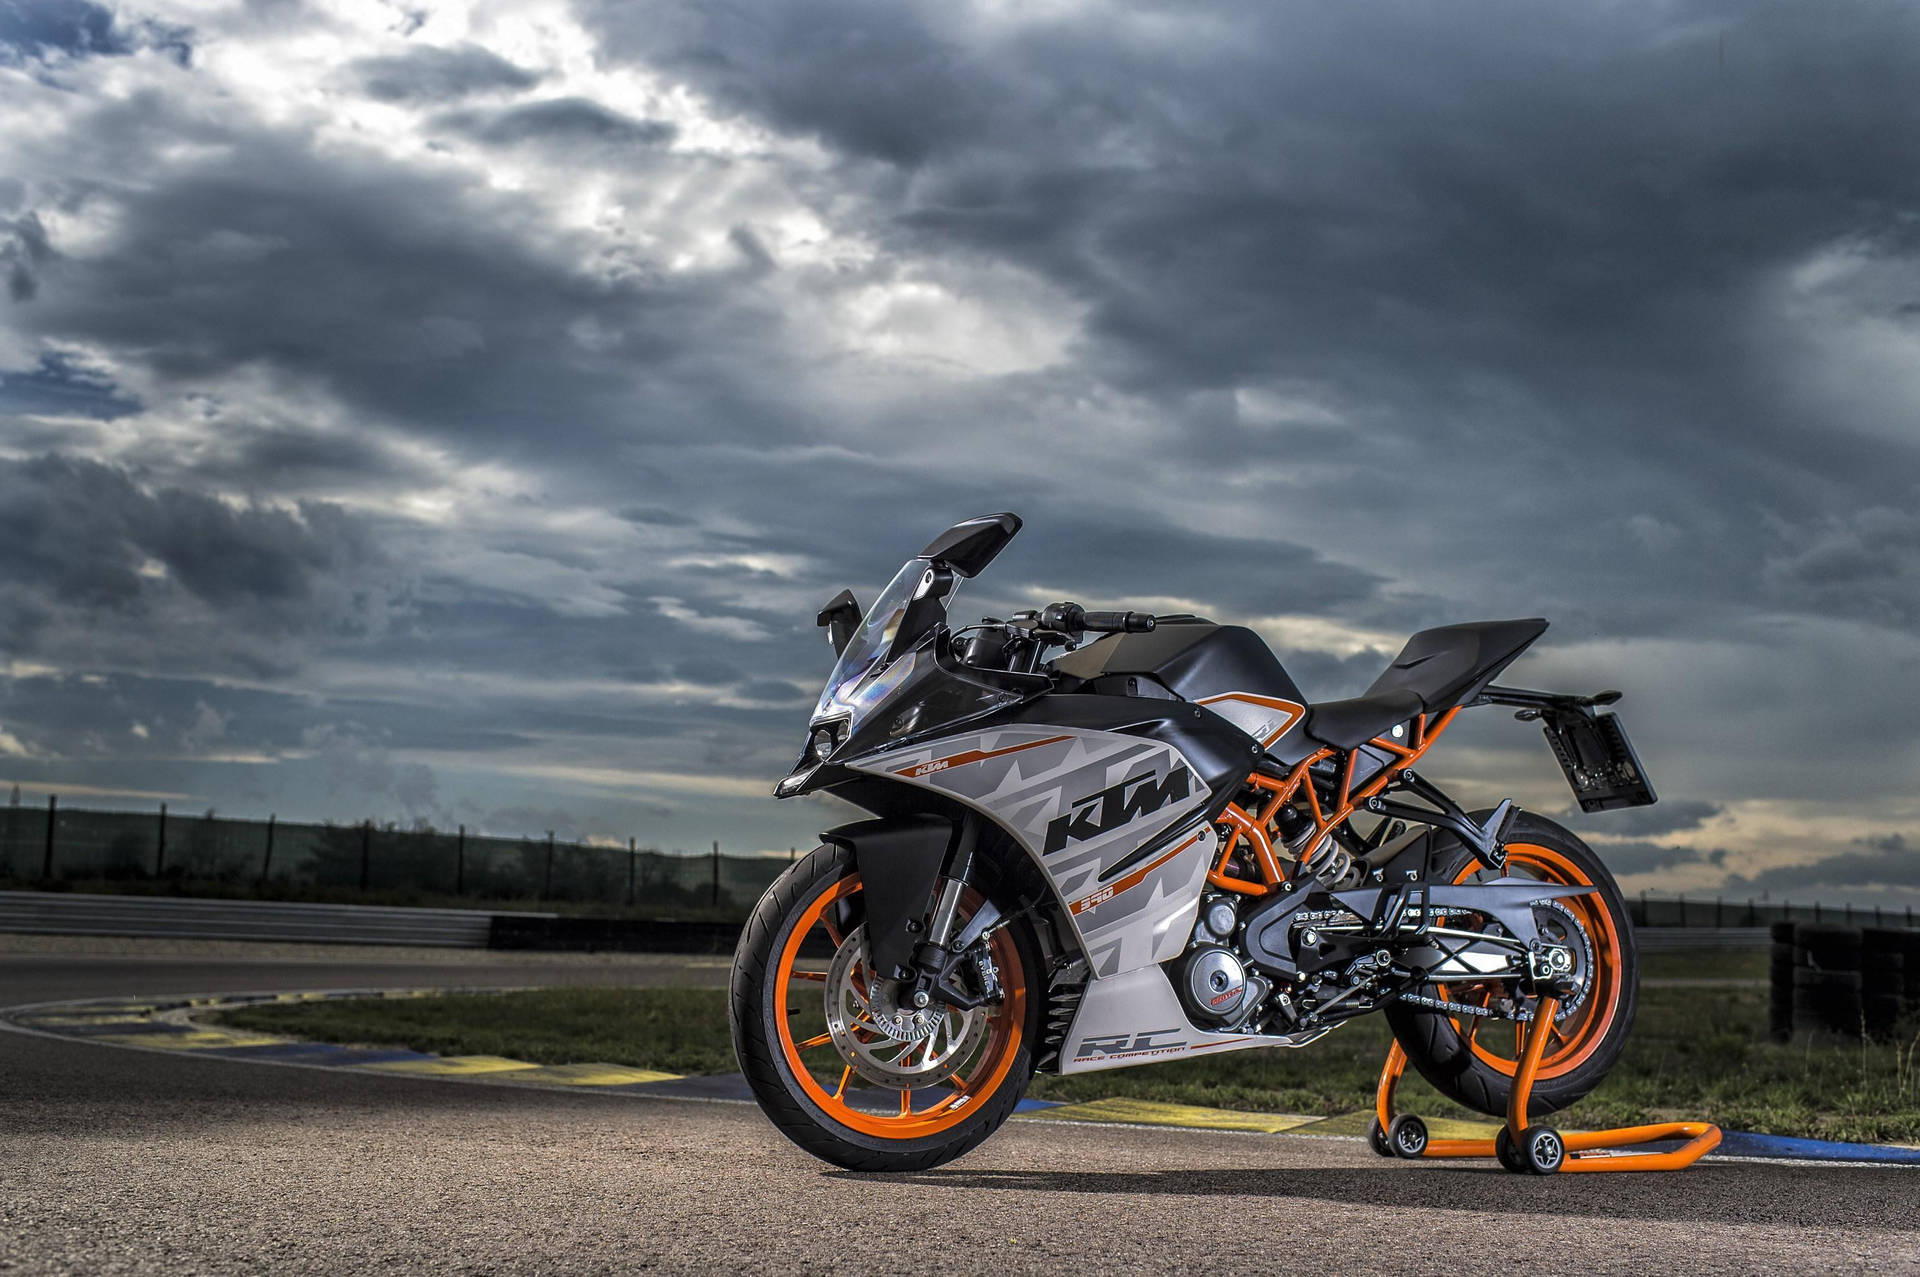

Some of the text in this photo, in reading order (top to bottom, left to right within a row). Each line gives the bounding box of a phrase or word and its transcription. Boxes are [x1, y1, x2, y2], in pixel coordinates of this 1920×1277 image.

[915, 760, 949, 777] KTM
[1043, 766, 1189, 856] KTM
[1076, 1028, 1188, 1057] RC
[1109, 1046, 1186, 1060] COMPETITION
